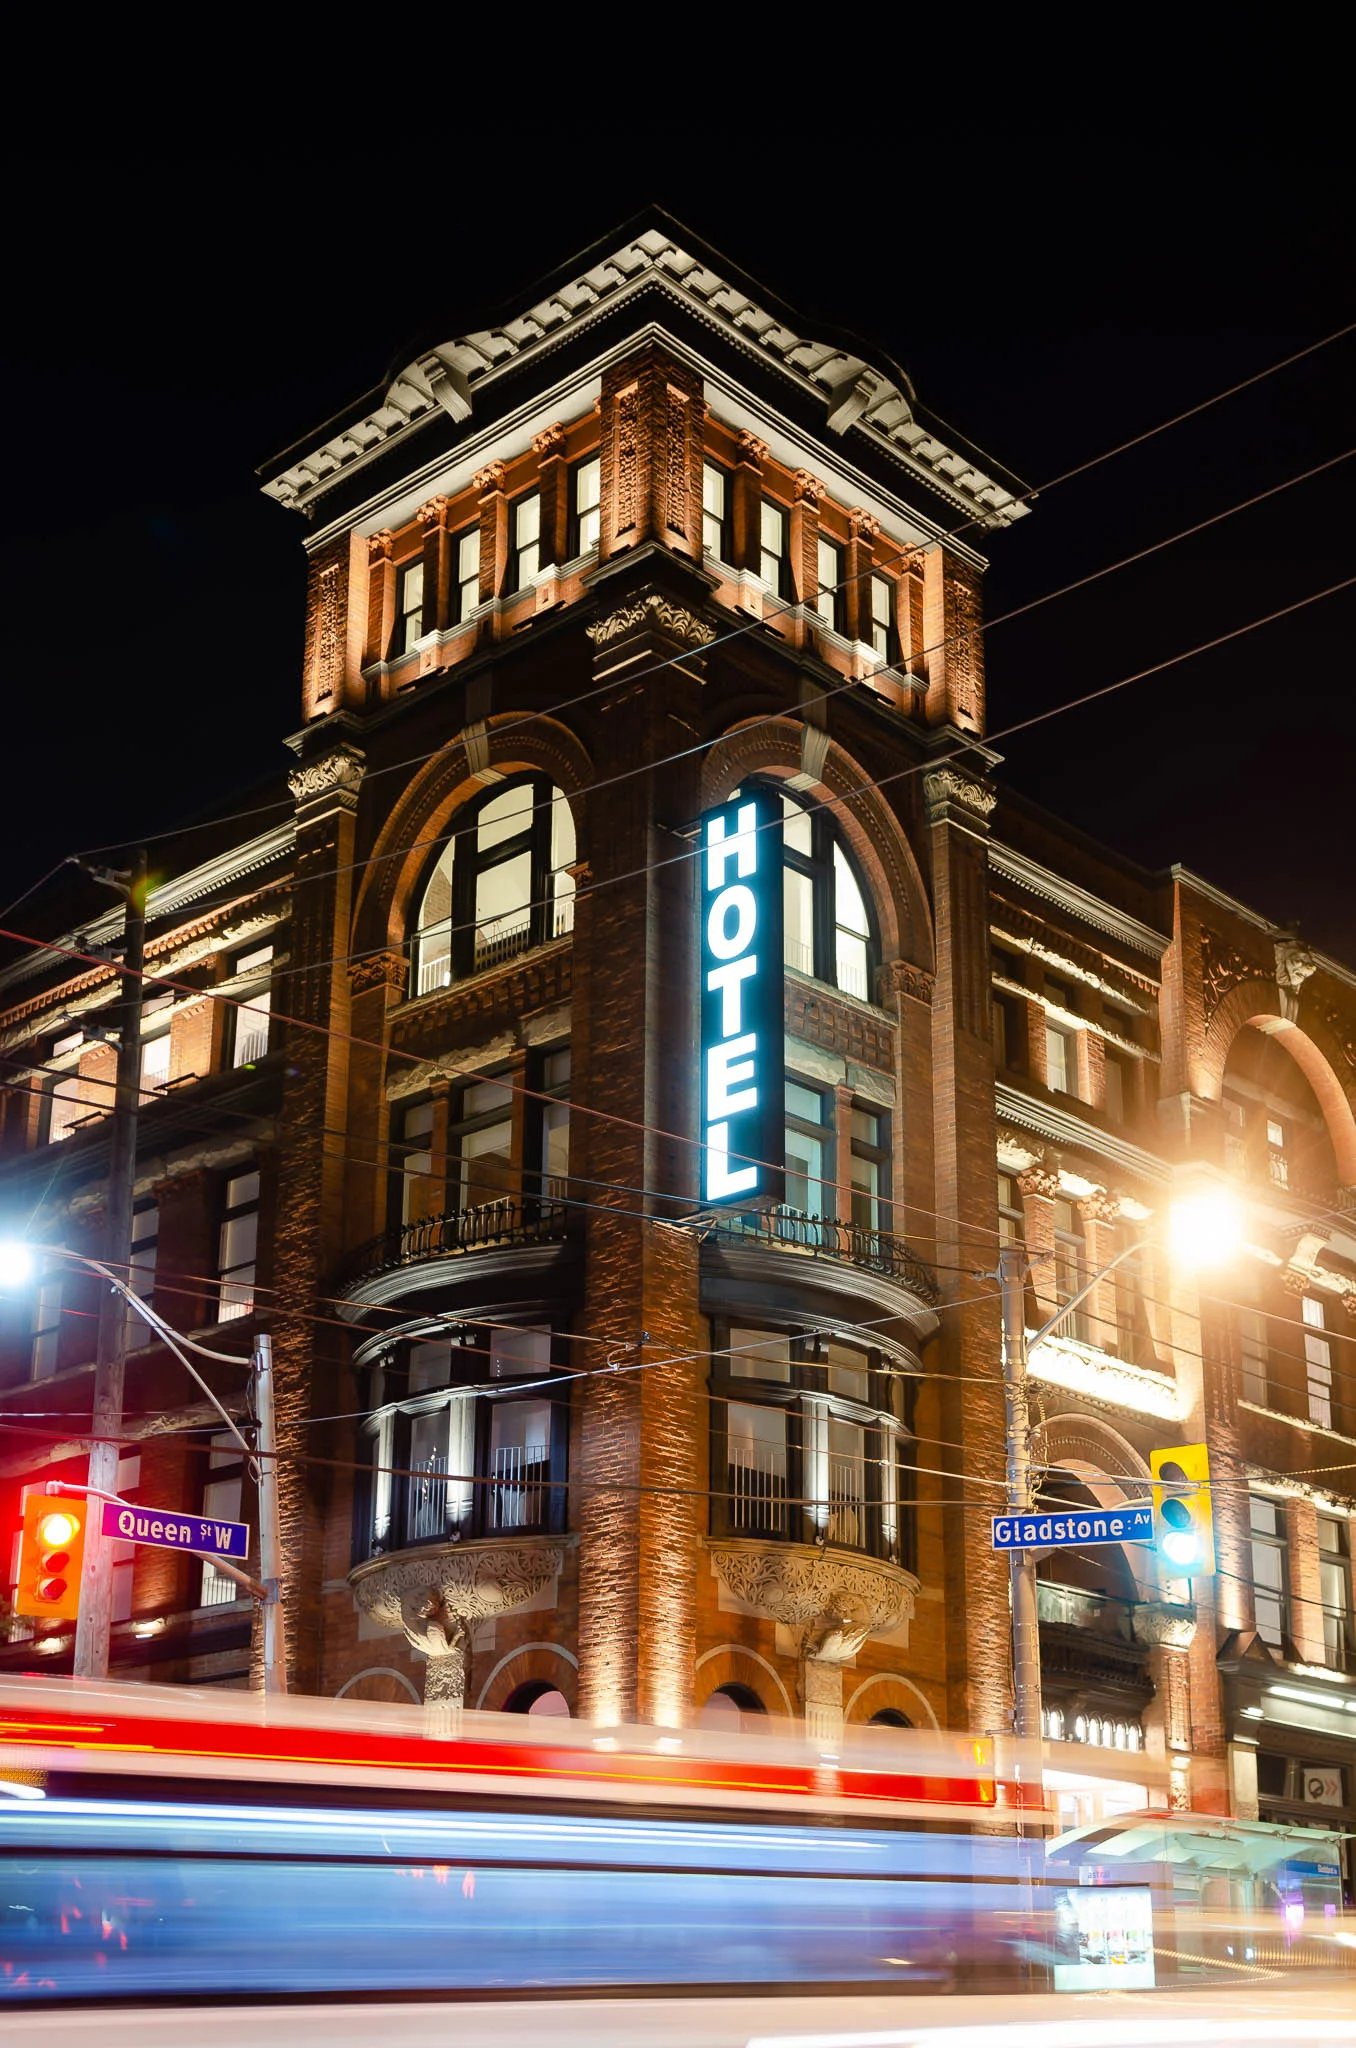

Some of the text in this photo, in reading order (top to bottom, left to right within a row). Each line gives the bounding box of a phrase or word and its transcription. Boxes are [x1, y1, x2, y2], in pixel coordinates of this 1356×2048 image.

[707, 802, 757, 1201] HOTEL
[118, 1510, 232, 1549] Queen St W
[995, 1513, 1150, 1542] Gladstone Av
